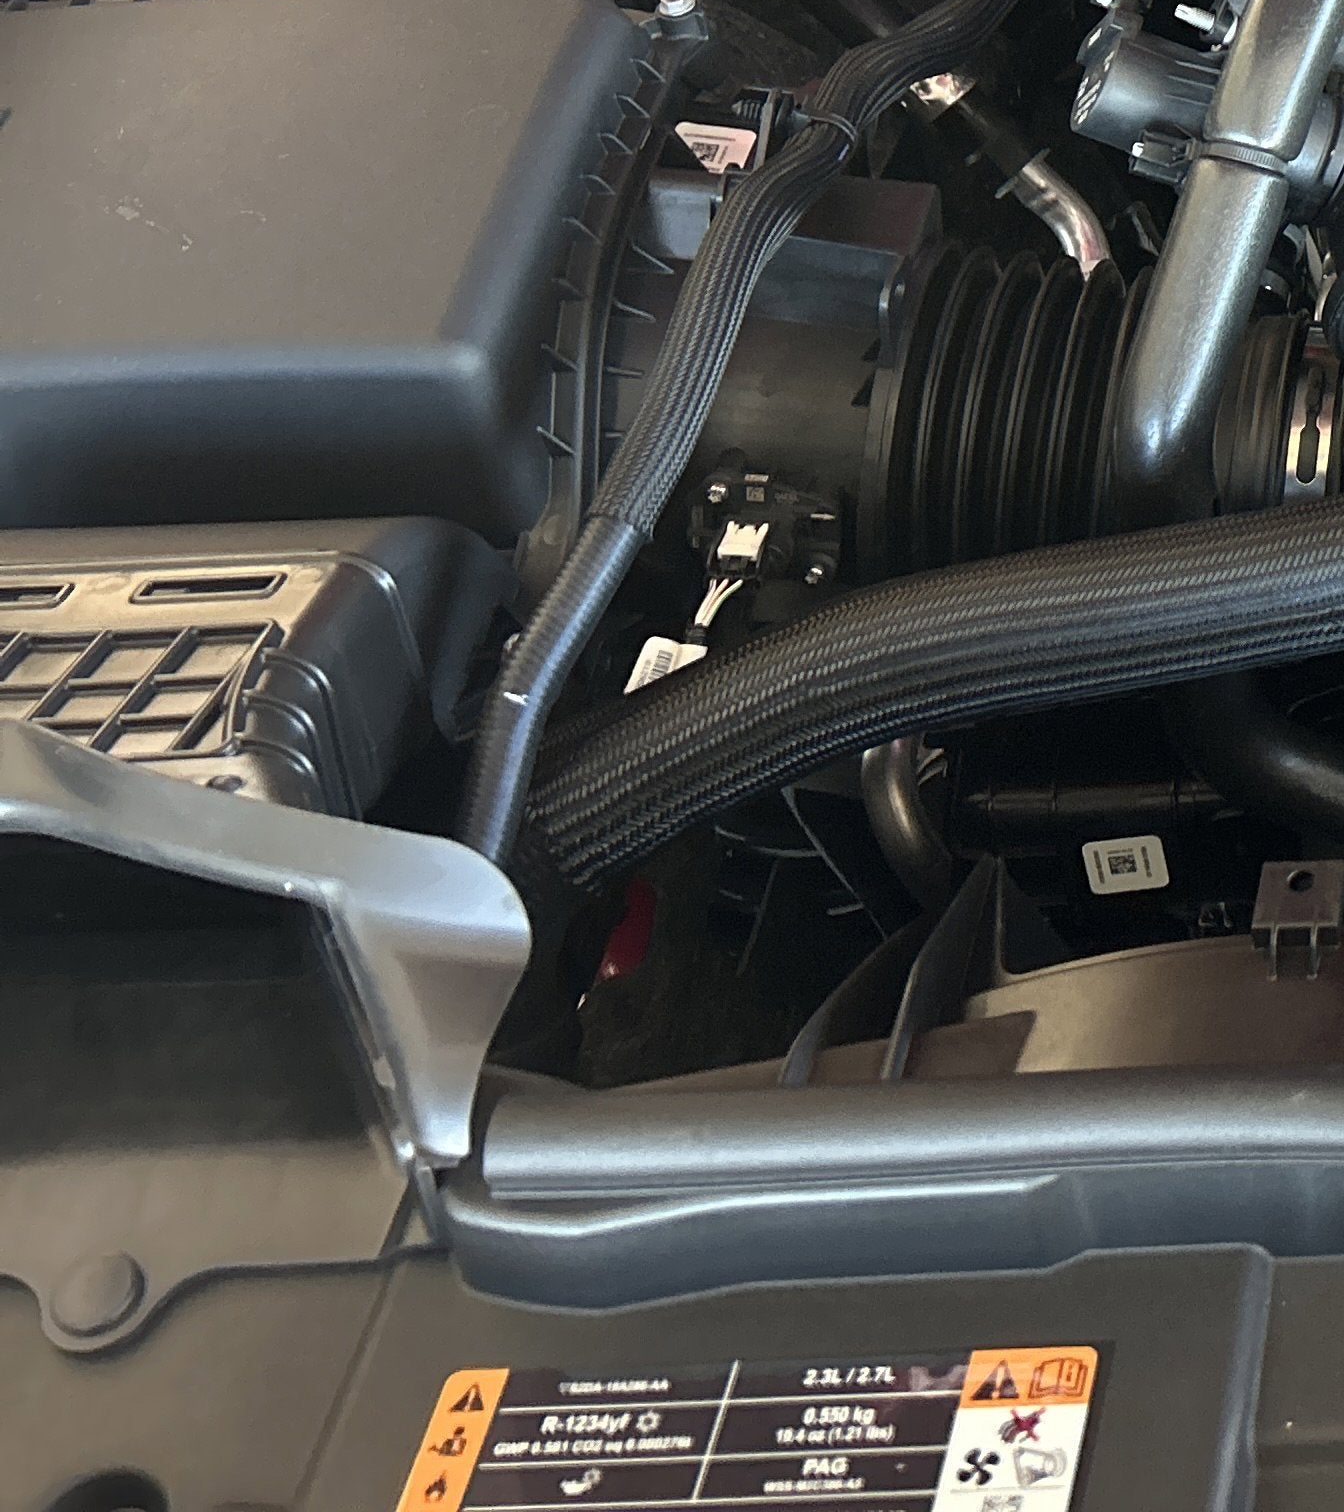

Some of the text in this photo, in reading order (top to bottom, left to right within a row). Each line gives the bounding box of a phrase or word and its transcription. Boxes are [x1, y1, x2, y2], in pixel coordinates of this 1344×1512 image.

[802, 1365, 898, 1387] 2.3L / 2.7L
[539, 1411, 632, 1435] R-1234yf
[802, 1405, 878, 1426] 0.550 kg
[828, 1425, 863, 1447] (1.21
[865, 1423, 896, 1445] lbs)
[802, 1457, 850, 1476] PAG
